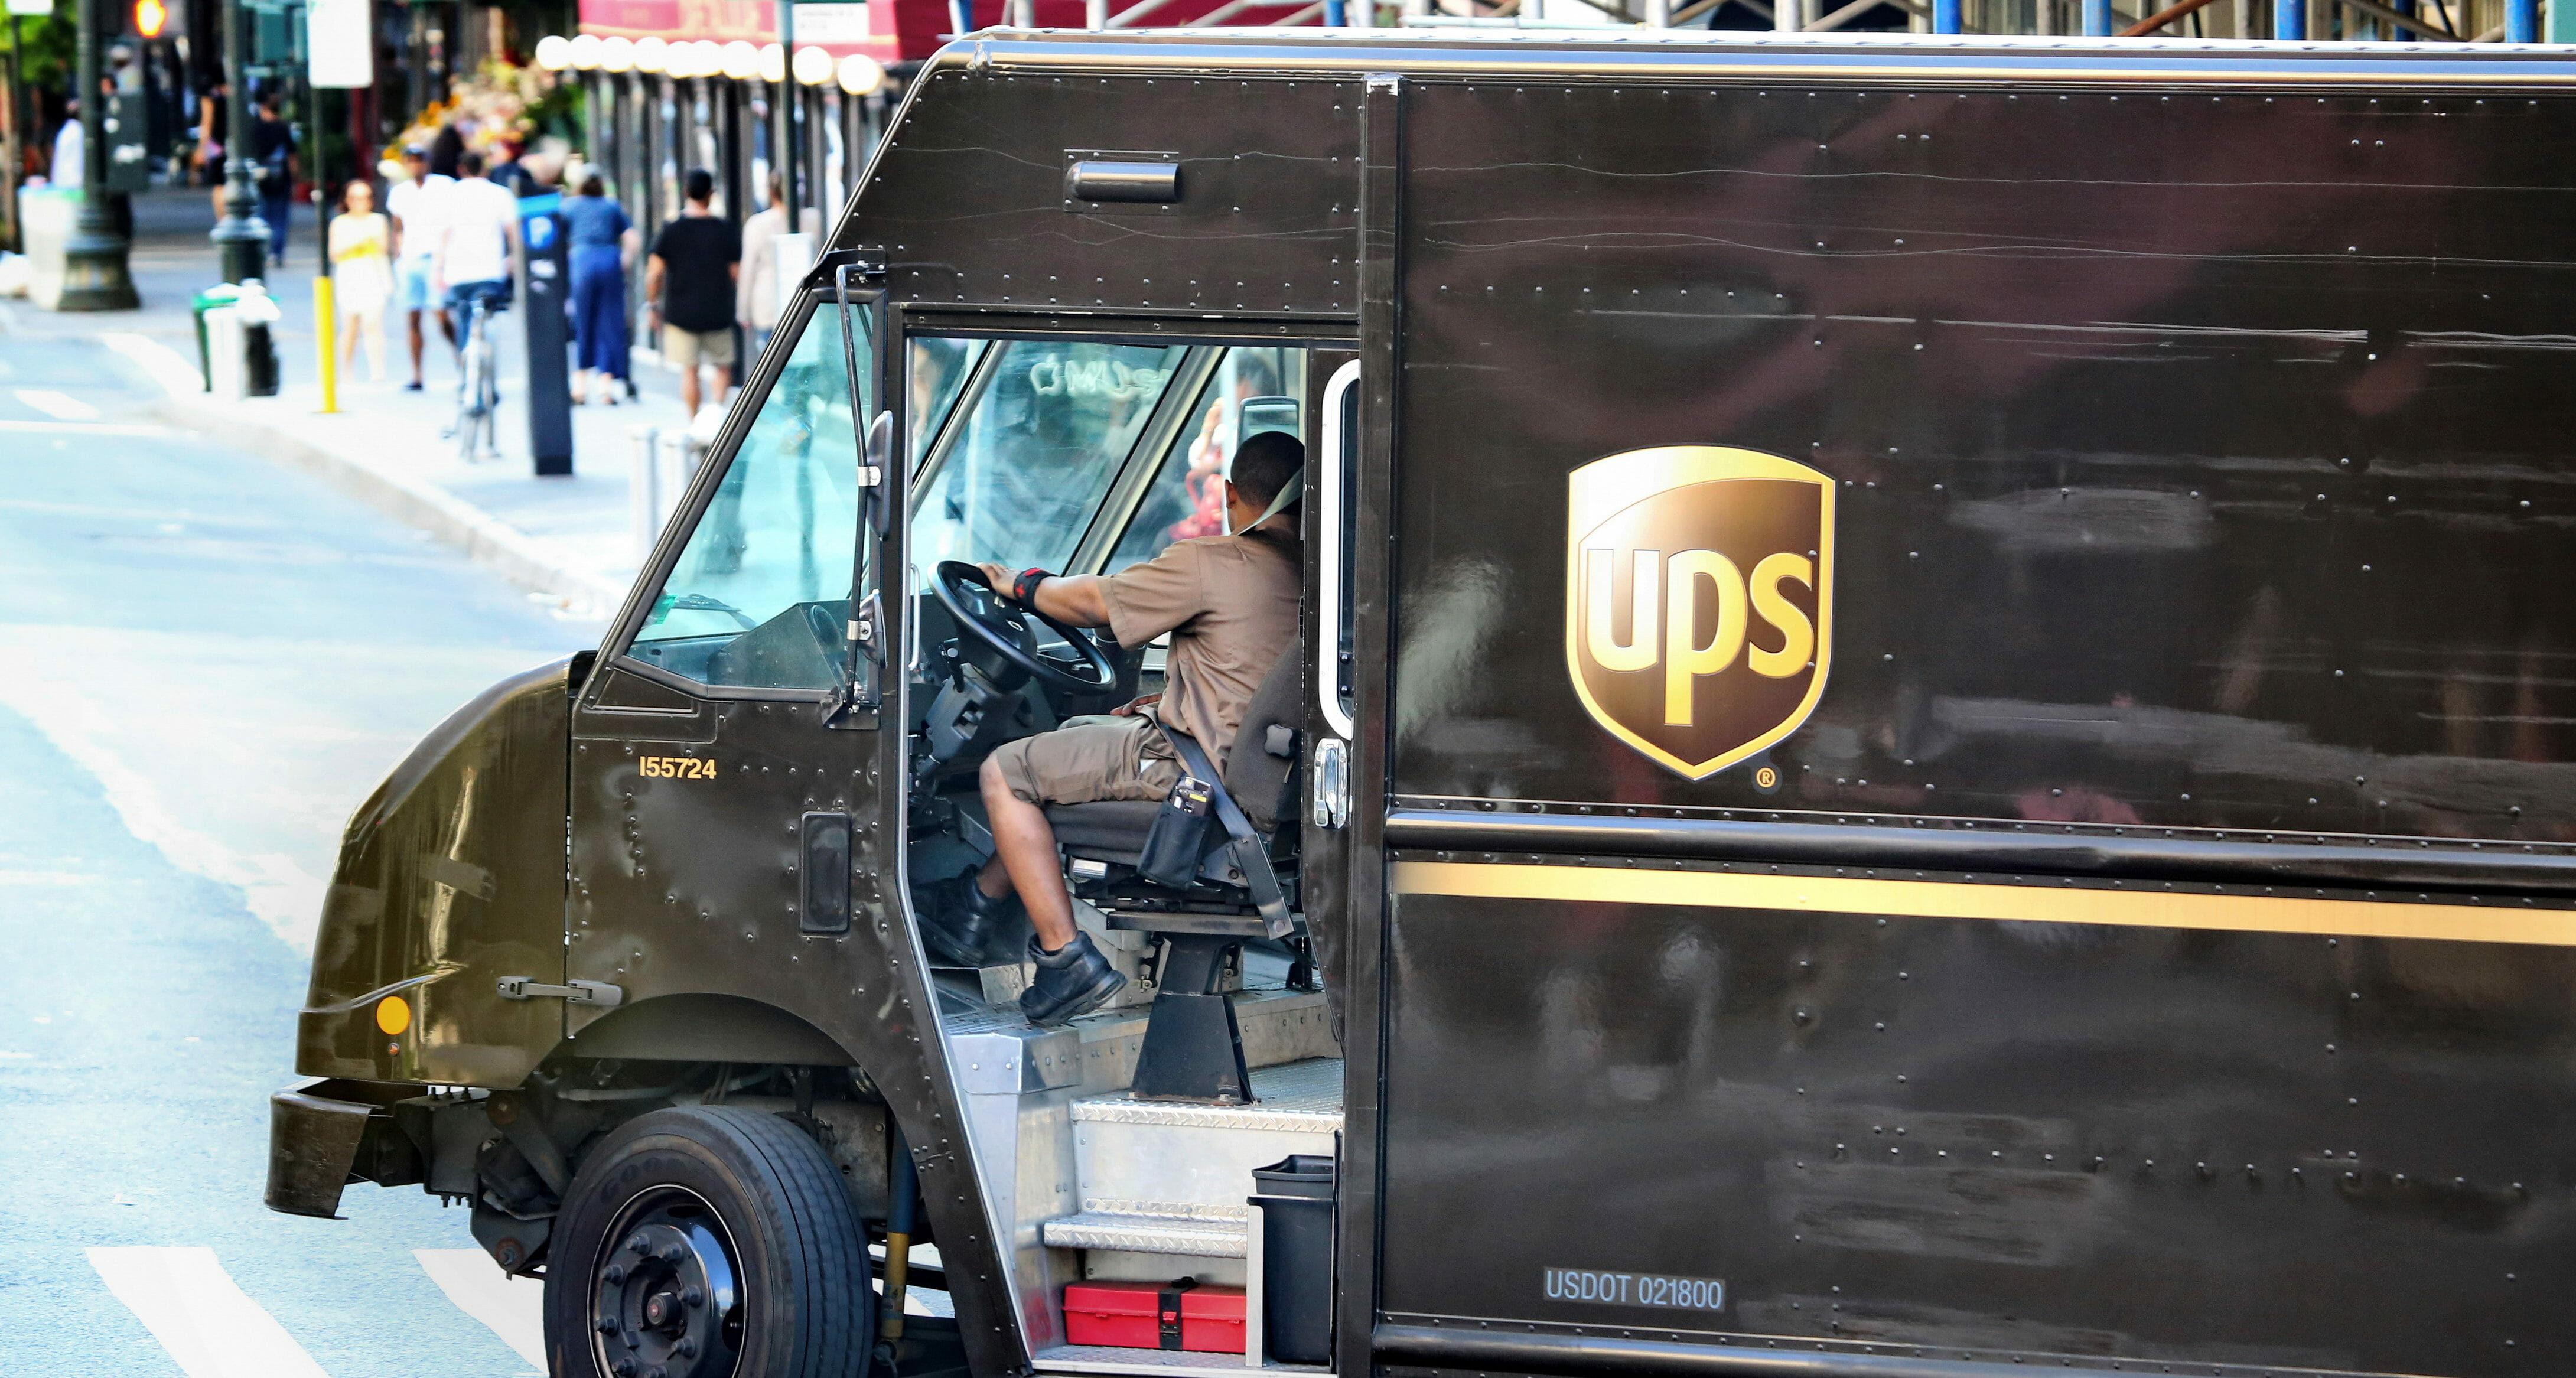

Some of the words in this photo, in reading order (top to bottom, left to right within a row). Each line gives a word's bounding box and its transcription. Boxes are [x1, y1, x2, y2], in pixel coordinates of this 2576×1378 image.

[1586, 549, 1814, 727] ups
[1546, 1270, 1632, 1302] USDOT
[1639, 1276, 1722, 1308] 021800
